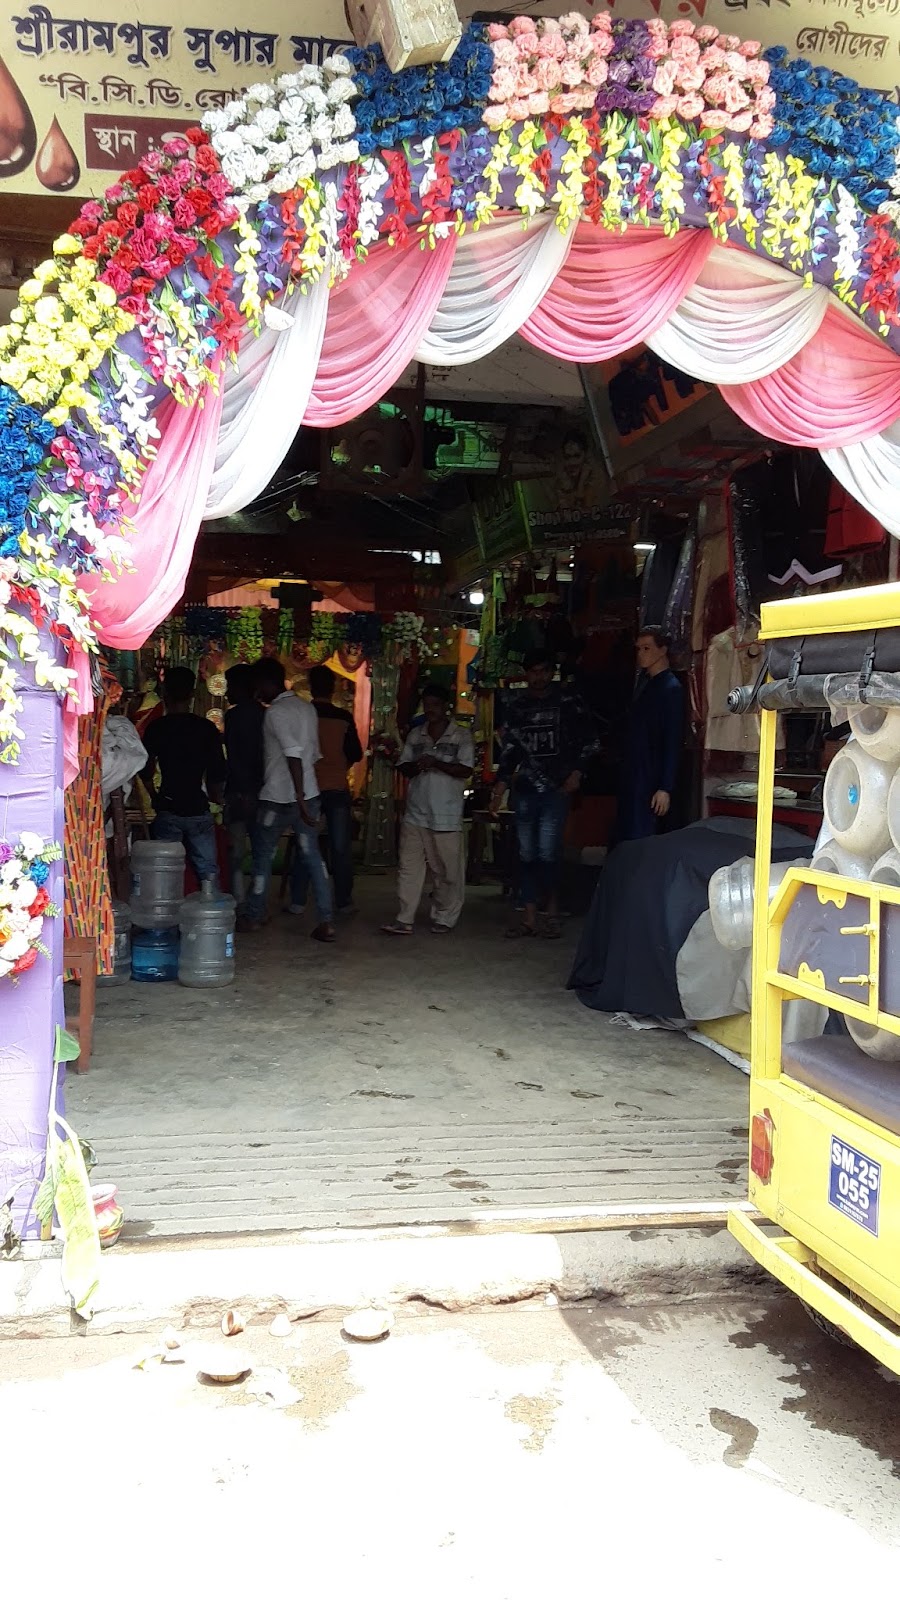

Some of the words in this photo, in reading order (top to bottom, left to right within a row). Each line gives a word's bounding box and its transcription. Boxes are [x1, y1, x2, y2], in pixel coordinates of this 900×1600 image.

[11, 5, 173, 68] শ্রীরামপুর
[183, 26, 280, 73] সুপার
[796, 21, 889, 59] রোগীদের
[91, 125, 138, 159] স্থান
[528, 510, 560, 527] Shop
[831, 1141, 879, 1191] SM-25
[838, 1171, 870, 1211] 055
